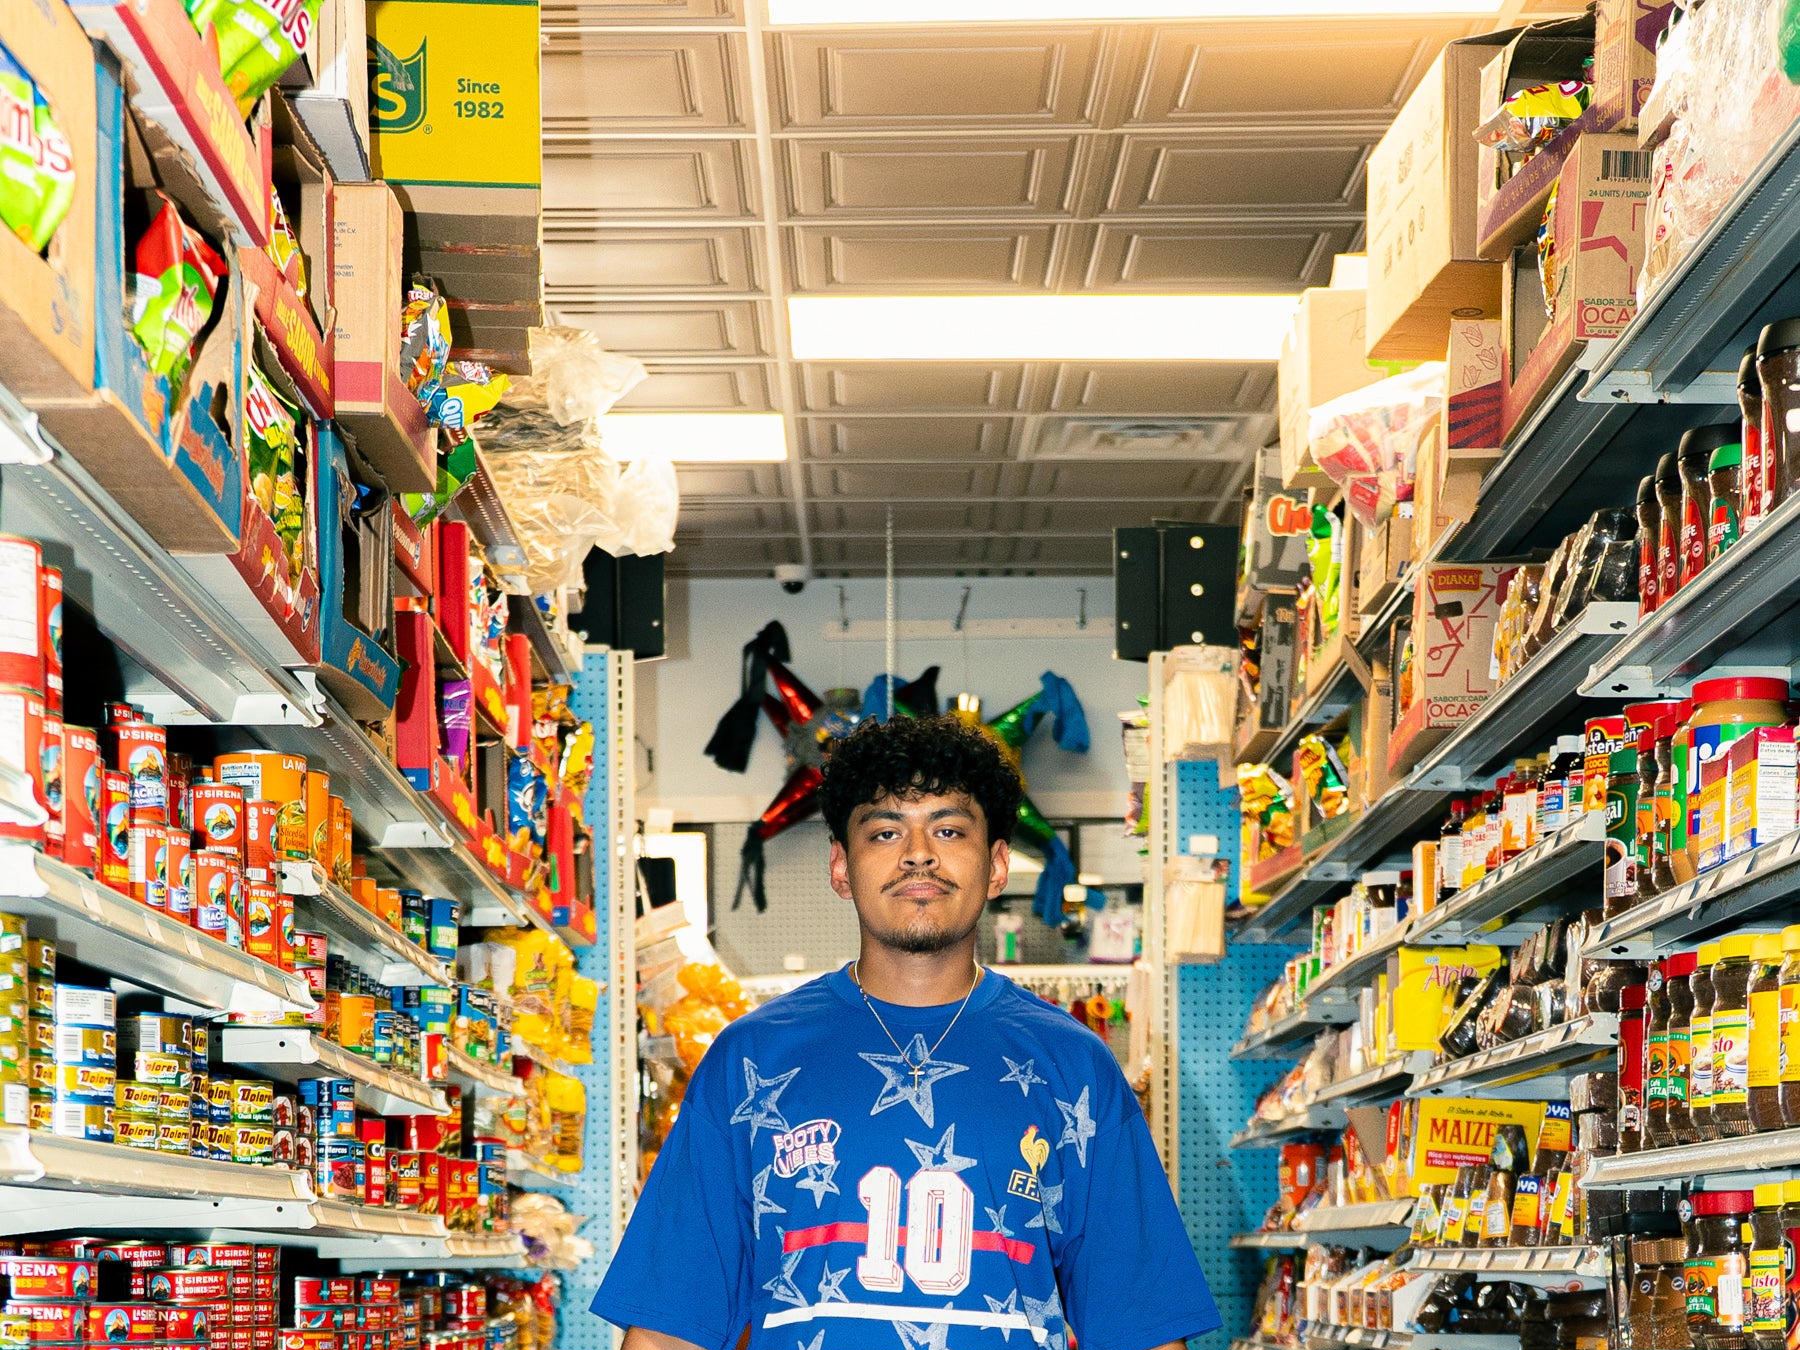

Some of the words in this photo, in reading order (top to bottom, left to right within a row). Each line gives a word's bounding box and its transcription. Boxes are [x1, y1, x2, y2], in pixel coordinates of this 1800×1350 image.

[456, 77, 500, 95] Since
[453, 100, 504, 119] 1982
[1588, 190, 1598, 198] 24
[1599, 190, 1621, 198] UNITS
[1584, 298, 1615, 307] SABOR
[1438, 575, 1475, 586] DIANA
[1590, 731, 1601, 742] La
[204, 790, 242, 800] SIRENA
[773, 1120, 831, 1156] FOOTY
[777, 1143, 835, 1177] VIBES
[857, 1166, 974, 1296] 10
[133, 1250, 162, 1258] SIRENA
[224, 1249, 251, 1258] SIRENA
[185, 1275, 219, 1285] SIRENA
[175, 1286, 208, 1295] SARDINES
